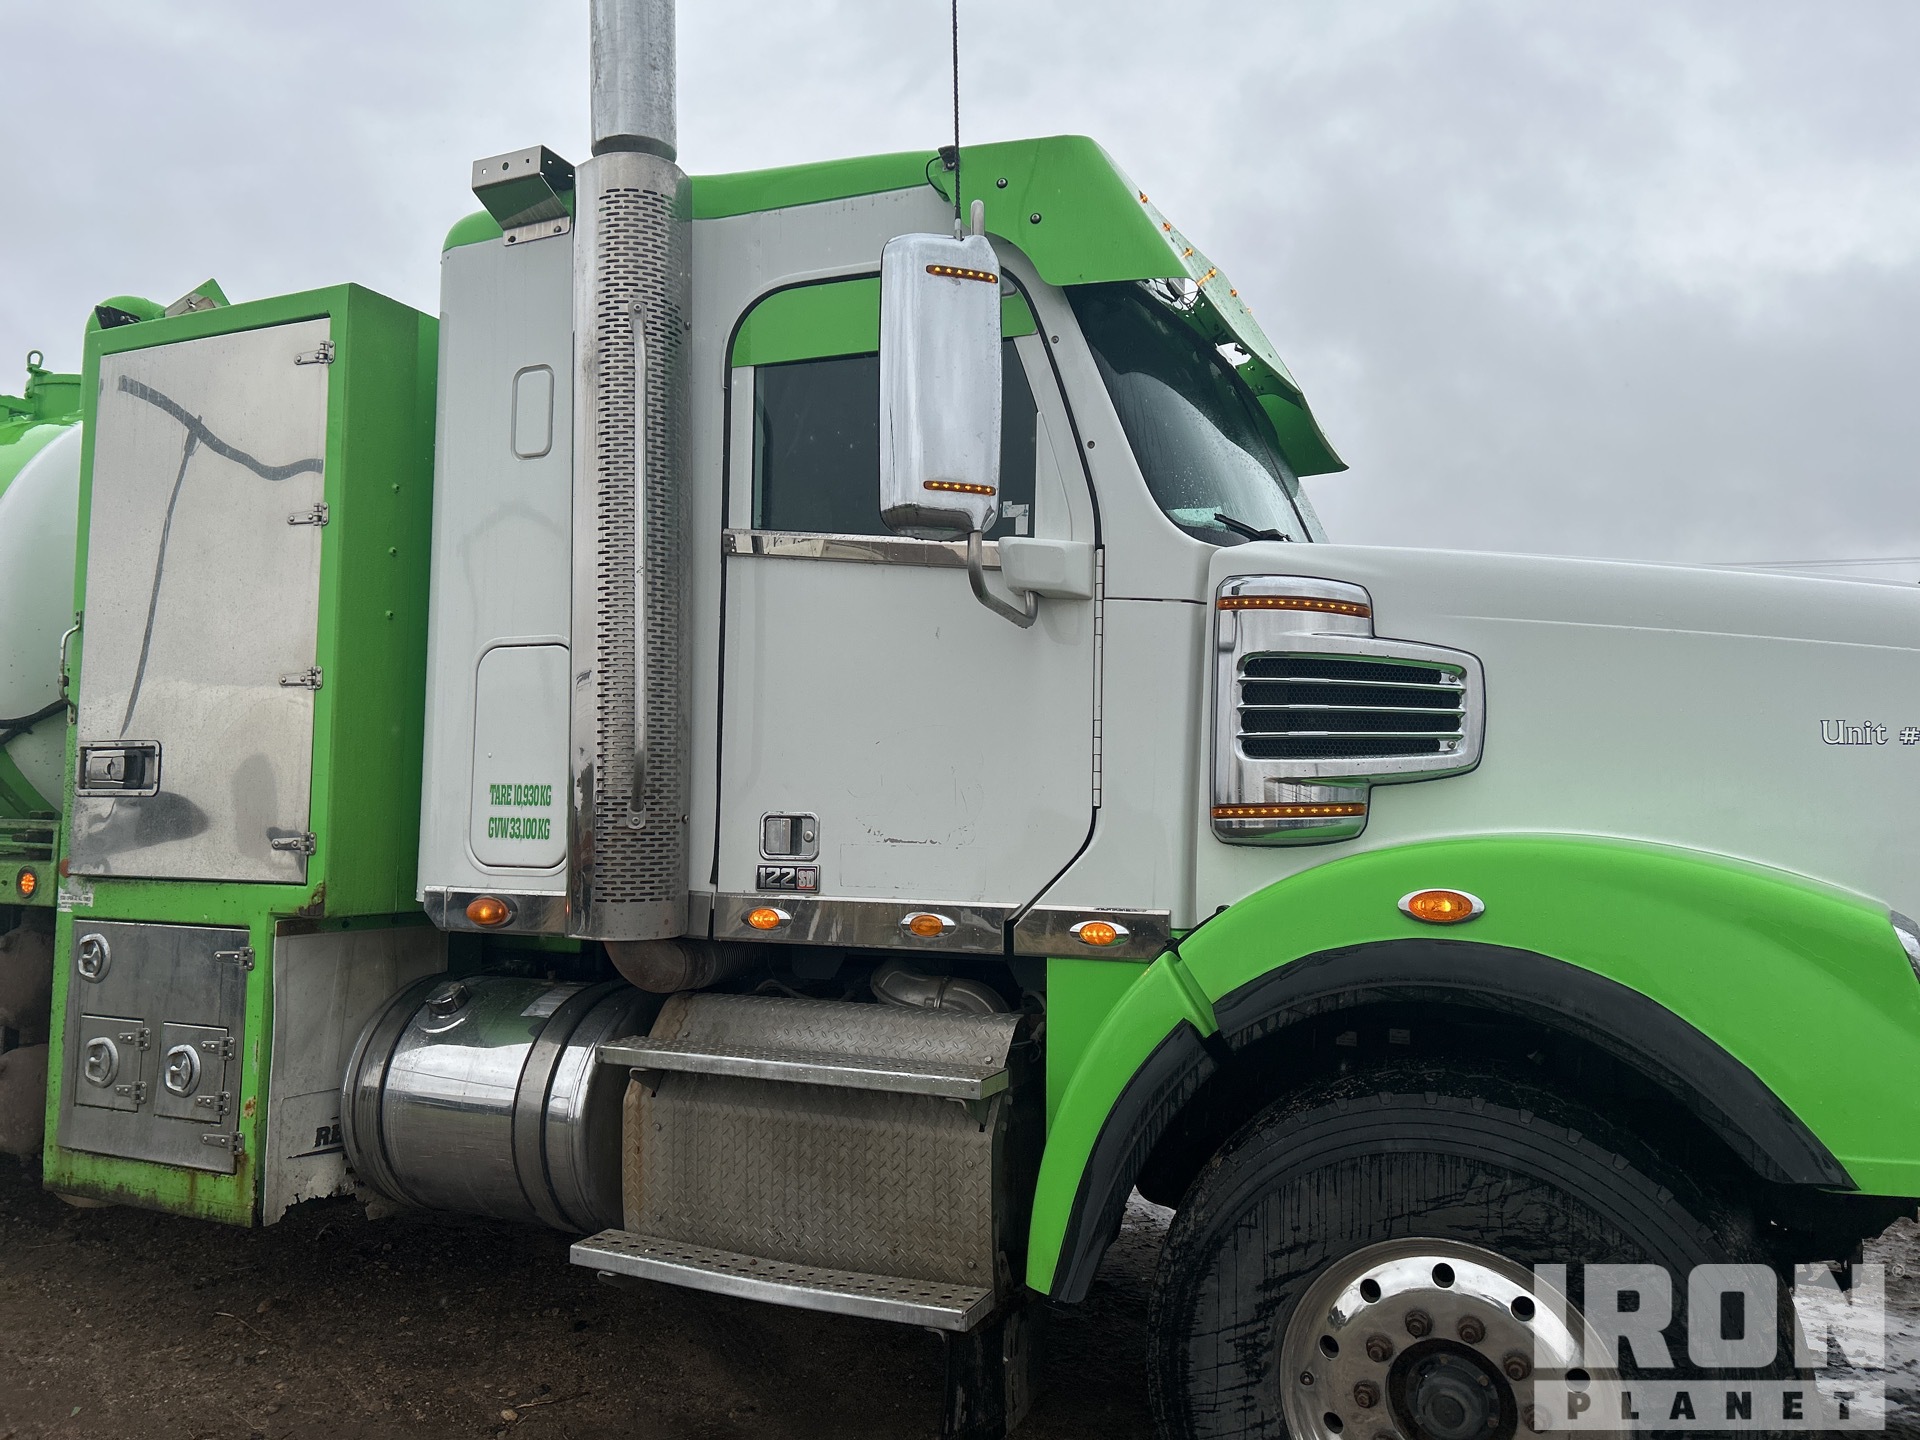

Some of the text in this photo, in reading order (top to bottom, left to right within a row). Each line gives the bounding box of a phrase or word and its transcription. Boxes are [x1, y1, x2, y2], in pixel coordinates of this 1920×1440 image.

[1820, 719, 1920, 745] Unit #
[489, 784, 512, 805] TARE
[488, 817, 509, 838] GVW
